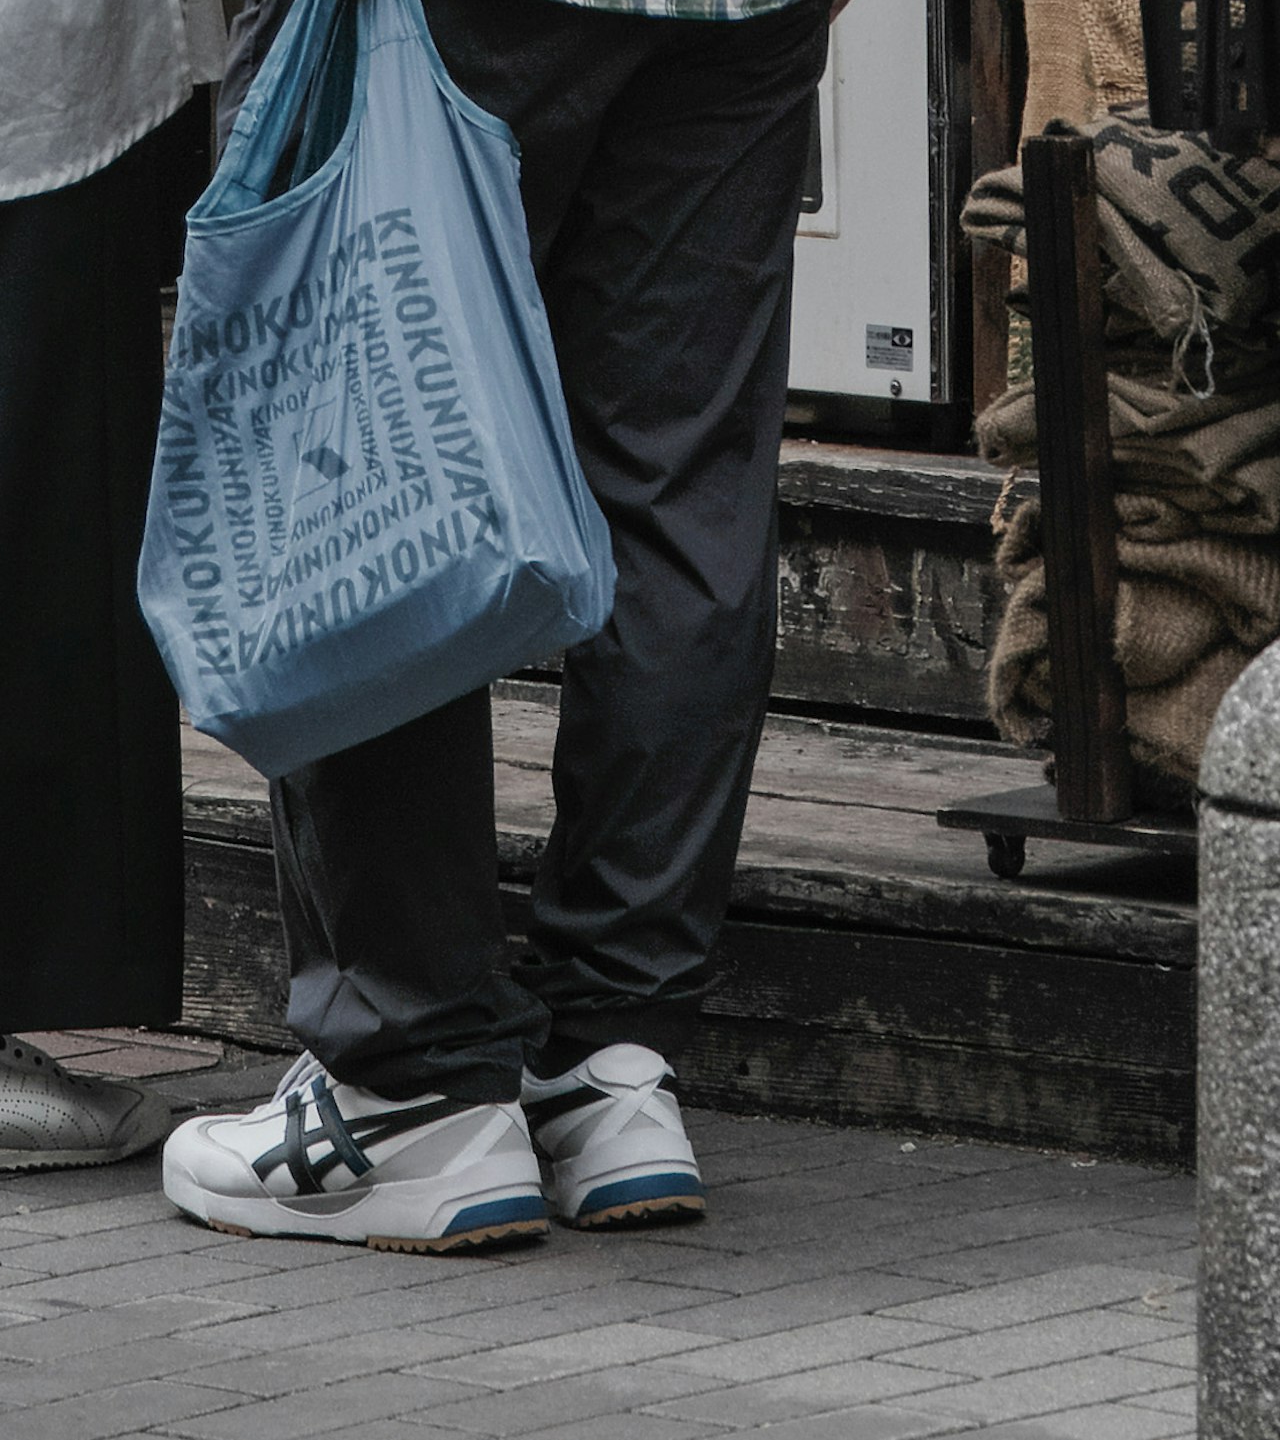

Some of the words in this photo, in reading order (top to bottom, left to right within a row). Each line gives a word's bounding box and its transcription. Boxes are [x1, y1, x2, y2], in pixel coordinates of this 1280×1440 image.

[358, 282, 427, 483] KINOKUNIYA
[374, 208, 491, 501] KINOKUNIYA
[207, 405, 266, 608] KINOKUNIYA
